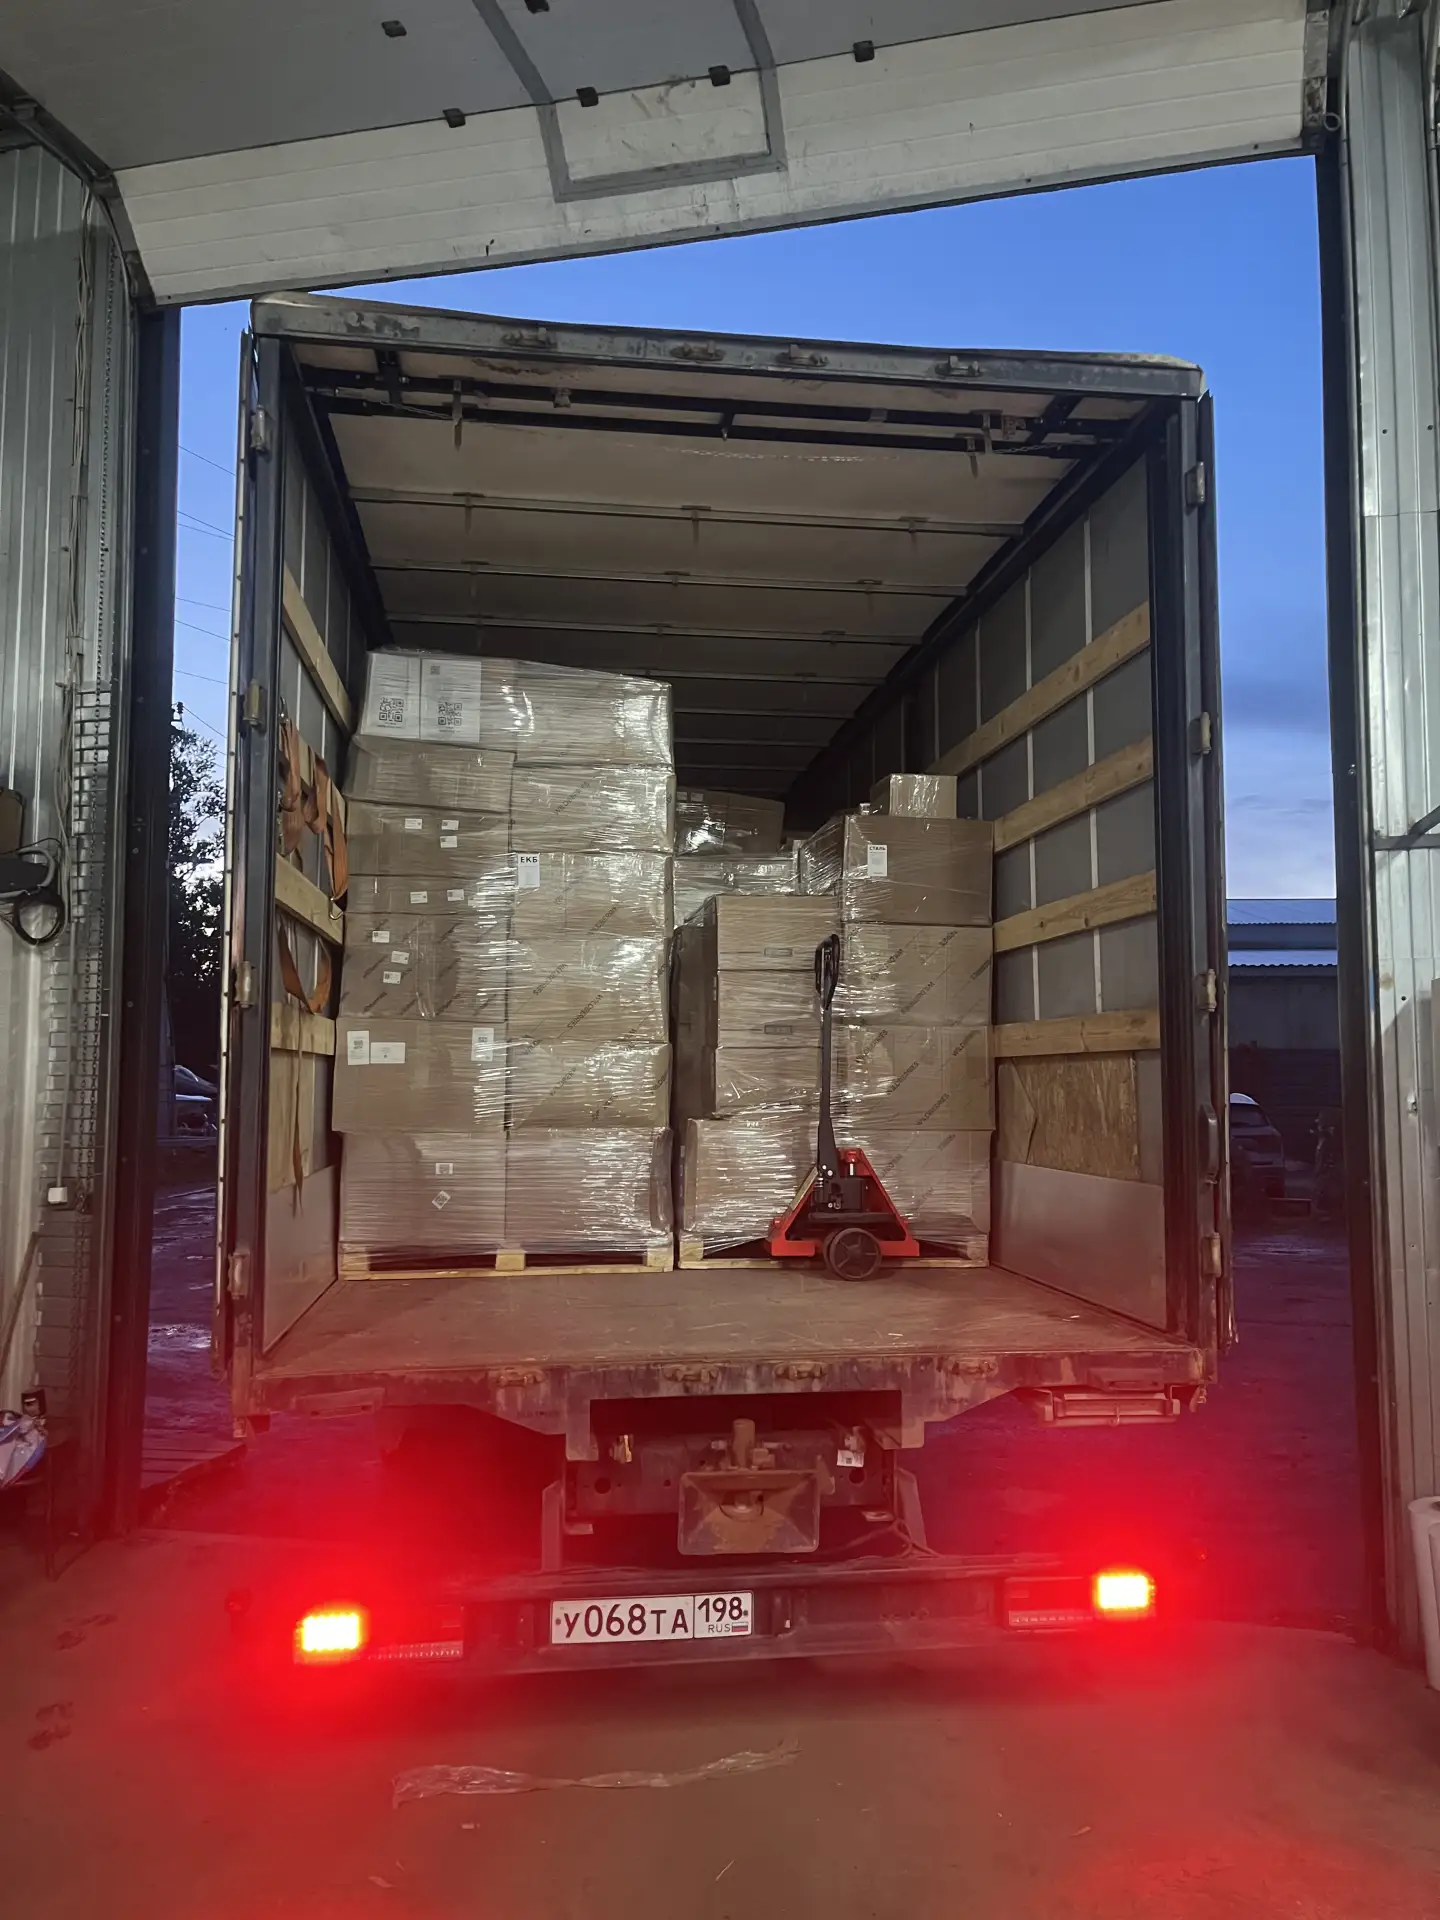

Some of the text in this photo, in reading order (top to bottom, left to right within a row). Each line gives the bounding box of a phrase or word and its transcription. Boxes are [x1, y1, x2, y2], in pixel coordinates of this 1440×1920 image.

[563, 1596, 743, 1638] У068ТА 198
[708, 1623, 731, 1634] RUS
